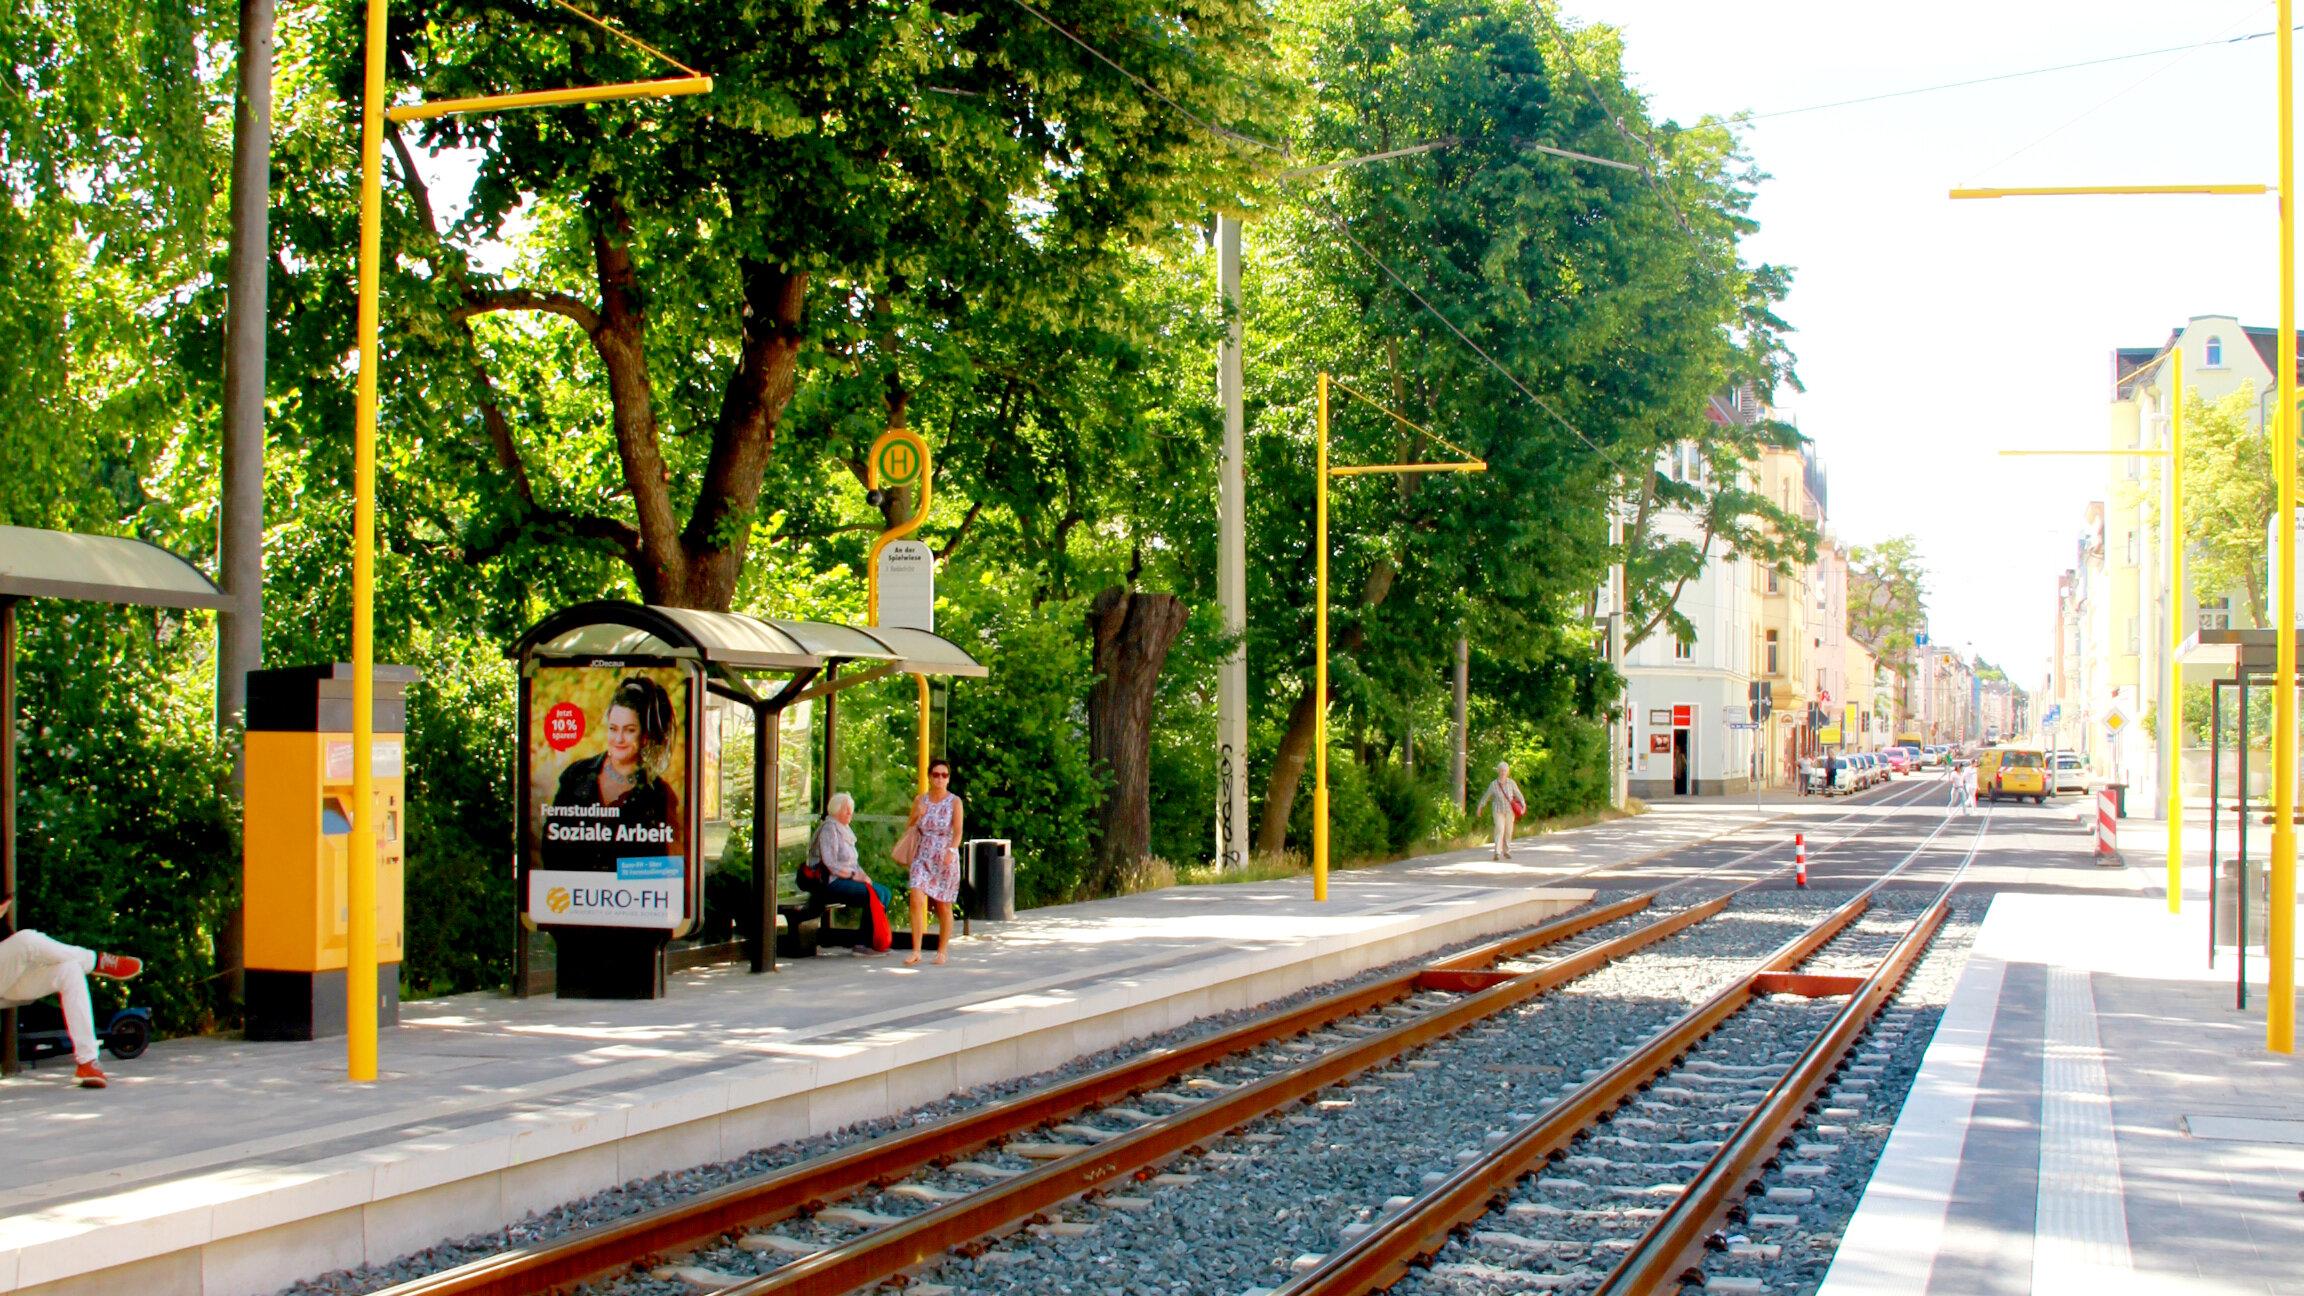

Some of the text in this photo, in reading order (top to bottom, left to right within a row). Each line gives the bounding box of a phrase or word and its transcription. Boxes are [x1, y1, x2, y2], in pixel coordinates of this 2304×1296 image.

[888, 554, 922, 562] Spielwiese
[552, 719, 578, 731] 10 %
[540, 803, 620, 818] Fernstudium
[547, 820, 674, 843] Soziale Arbeit
[572, 888, 669, 909] EURO-FH
